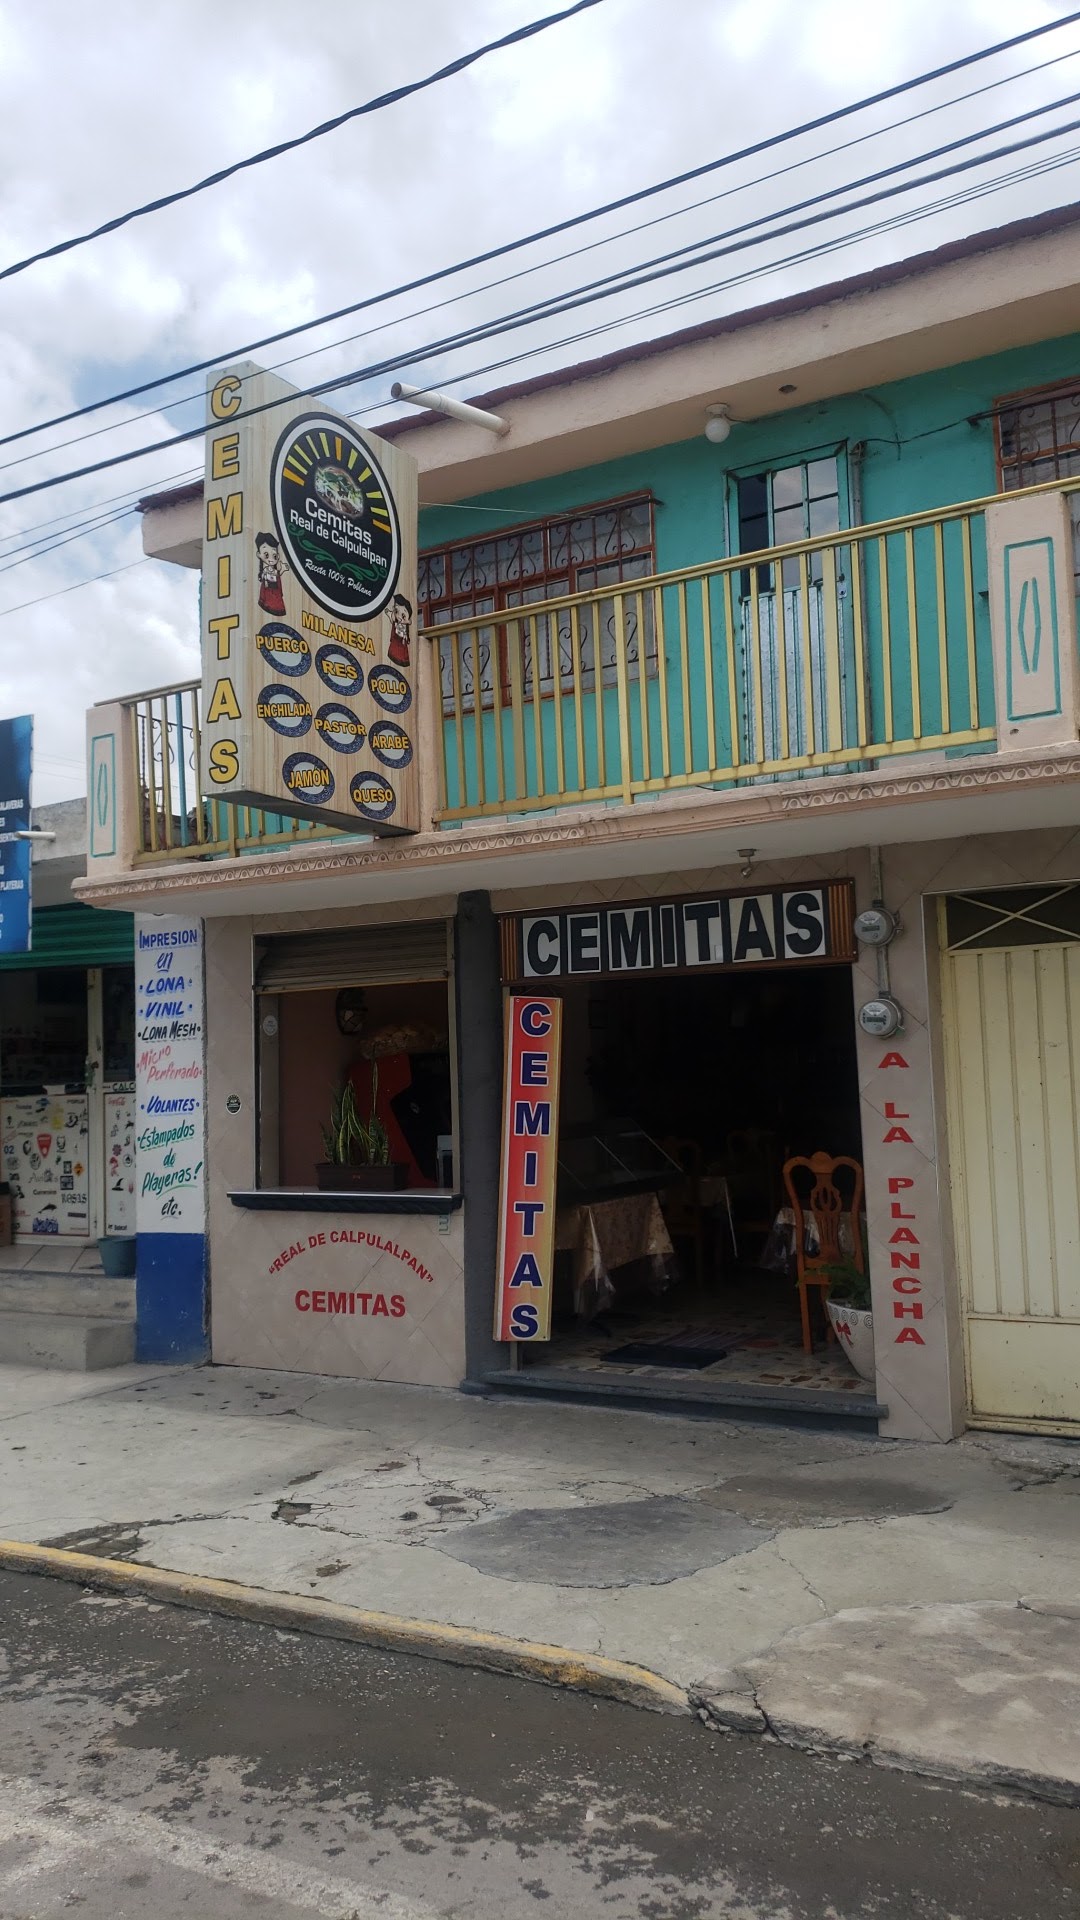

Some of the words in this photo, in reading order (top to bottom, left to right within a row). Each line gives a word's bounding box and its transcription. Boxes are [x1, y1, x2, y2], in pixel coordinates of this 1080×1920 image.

[305, 497, 372, 545] Cemitas
[290, 508, 314, 532] Real
[316, 523, 329, 539] de
[331, 530, 387, 568] Calpulalpan
[206, 375, 243, 784] CEMITAS
[305, 558, 326, 576] Receta
[328, 568, 345, 585] 100%
[347, 577, 372, 597] Poblana
[302, 610, 376, 656] MILANESA
[256, 634, 309, 654] PUERCO
[321, 659, 358, 680] RES
[370, 678, 407, 695] POLLO
[257, 702, 312, 718] ENCHILADA
[314, 718, 367, 736] PASTOR
[353, 788, 393, 803] QUESO
[139, 929, 198, 949] IMPRESION
[525, 892, 826, 975] CEMITAS
[155, 951, 174, 970] en
[146, 976, 185, 994] LONA
[145, 1001, 185, 1018] VINIL
[141, 1026, 168, 1041] LONA
[169, 1020, 197, 1039] MESH
[139, 1045, 171, 1073] Micro
[878, 1052, 910, 1069] A
[147, 1095, 195, 1114] VOLANTES
[882, 1102, 914, 1143] LA
[140, 1120, 195, 1150] Estampados
[163, 1148, 176, 1167] de
[508, 1002, 552, 1339] CEMITAS
[161, 1196, 182, 1216] etc.
[308, 1233, 327, 1249] DE
[888, 1177, 926, 1346] PLANCHA
[295, 1289, 406, 1318] CEMITAS
